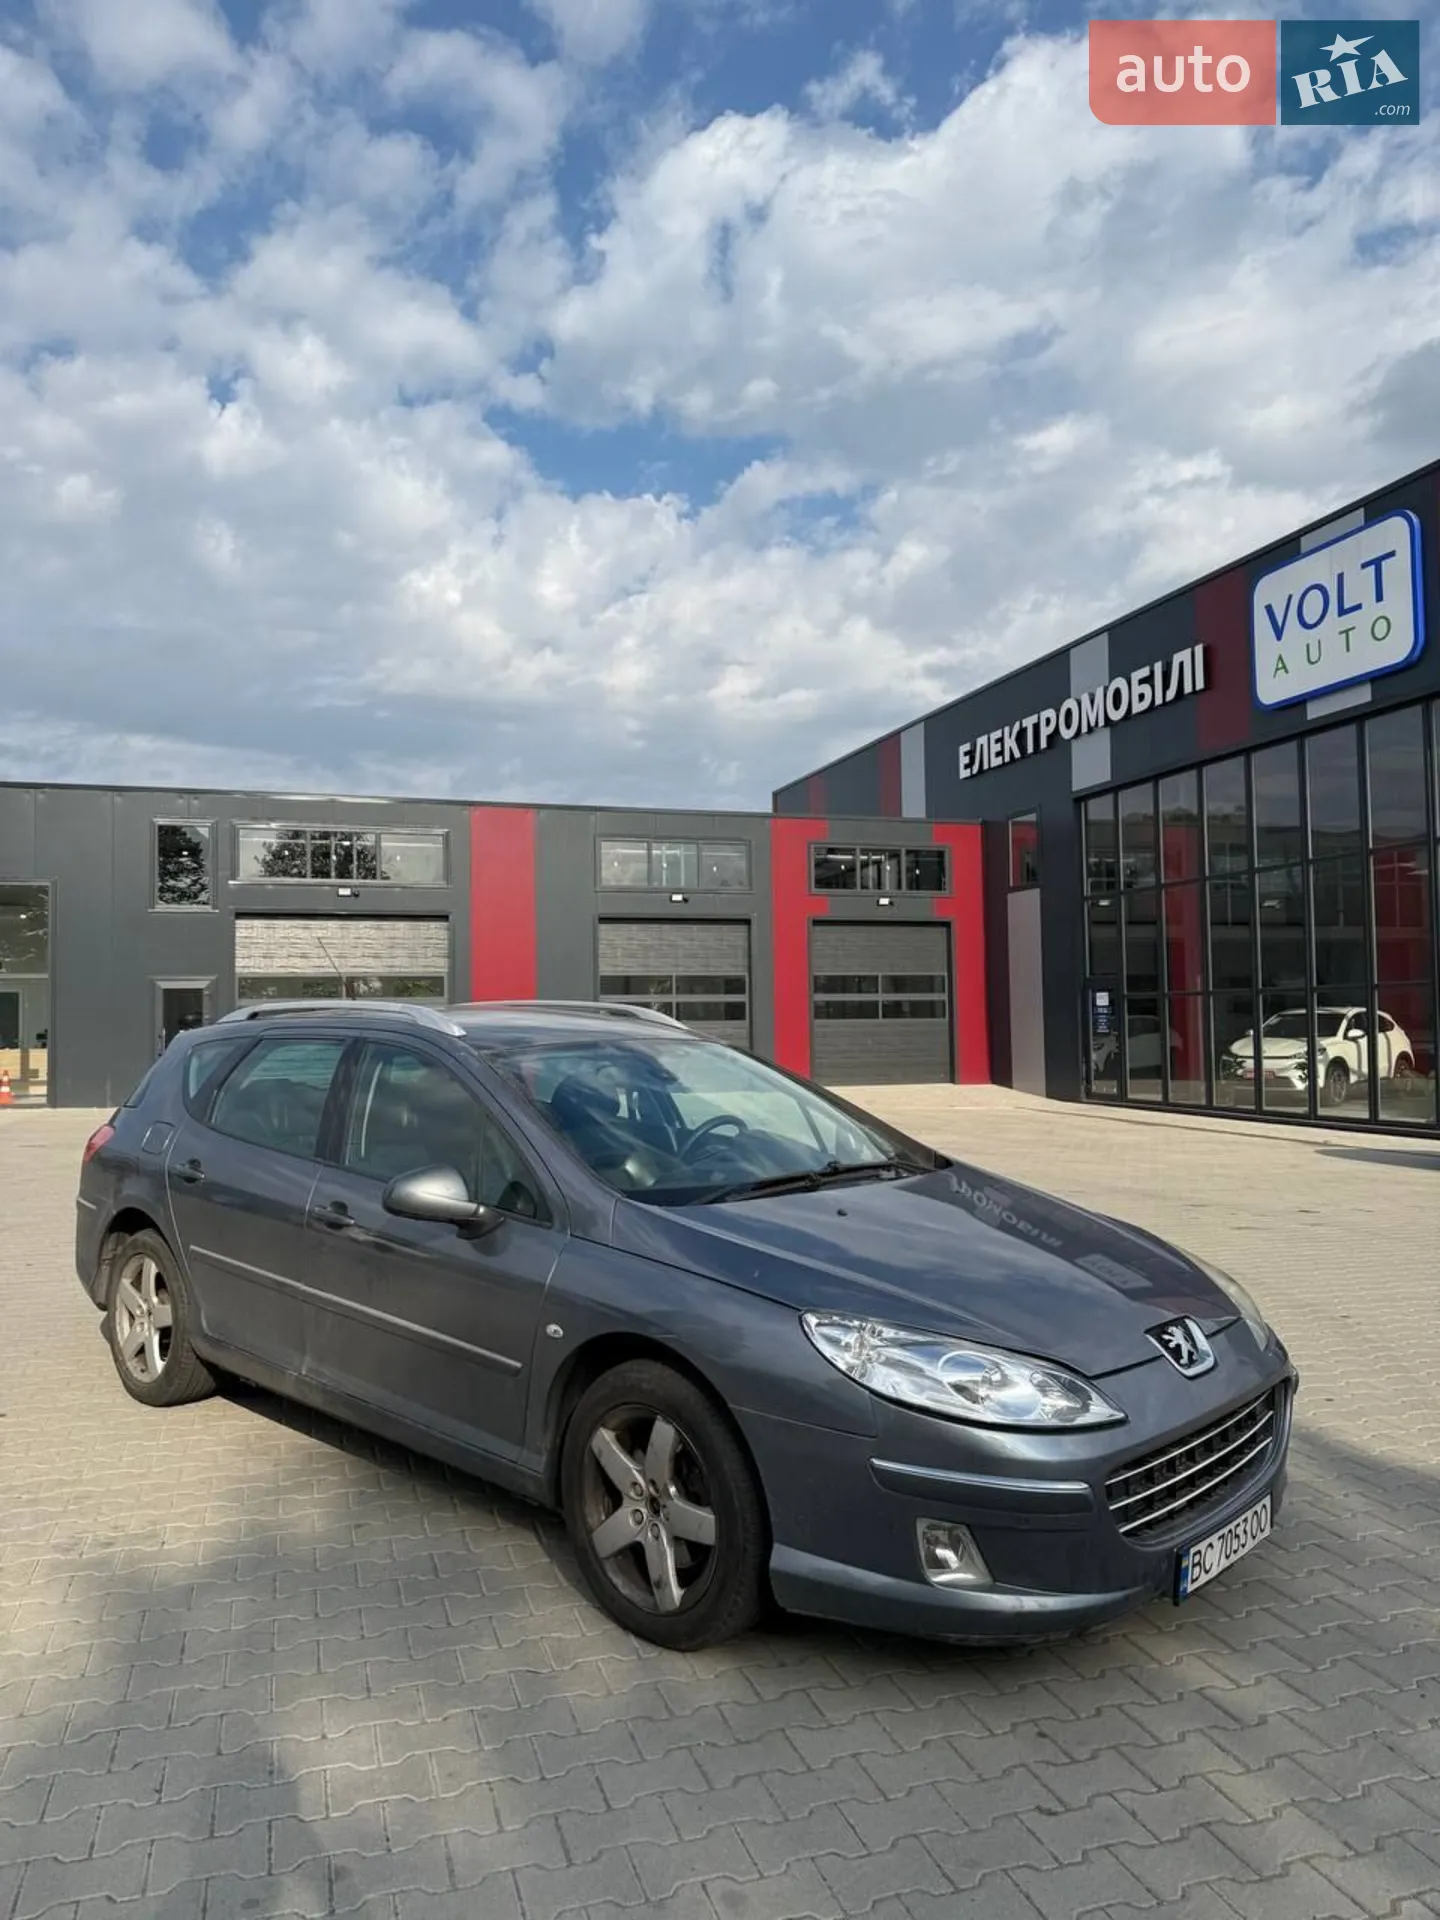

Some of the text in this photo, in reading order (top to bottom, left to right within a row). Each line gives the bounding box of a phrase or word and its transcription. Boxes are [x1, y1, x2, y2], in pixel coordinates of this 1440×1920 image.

[1264, 549, 1397, 642] VOLT
[1273, 615, 1392, 679] AUTO
[958, 643, 1206, 780] ЕЛЕКТРОМОБІЛІ
[1190, 1541, 1214, 1584] BC
[1217, 1516, 1248, 1567] 7053
